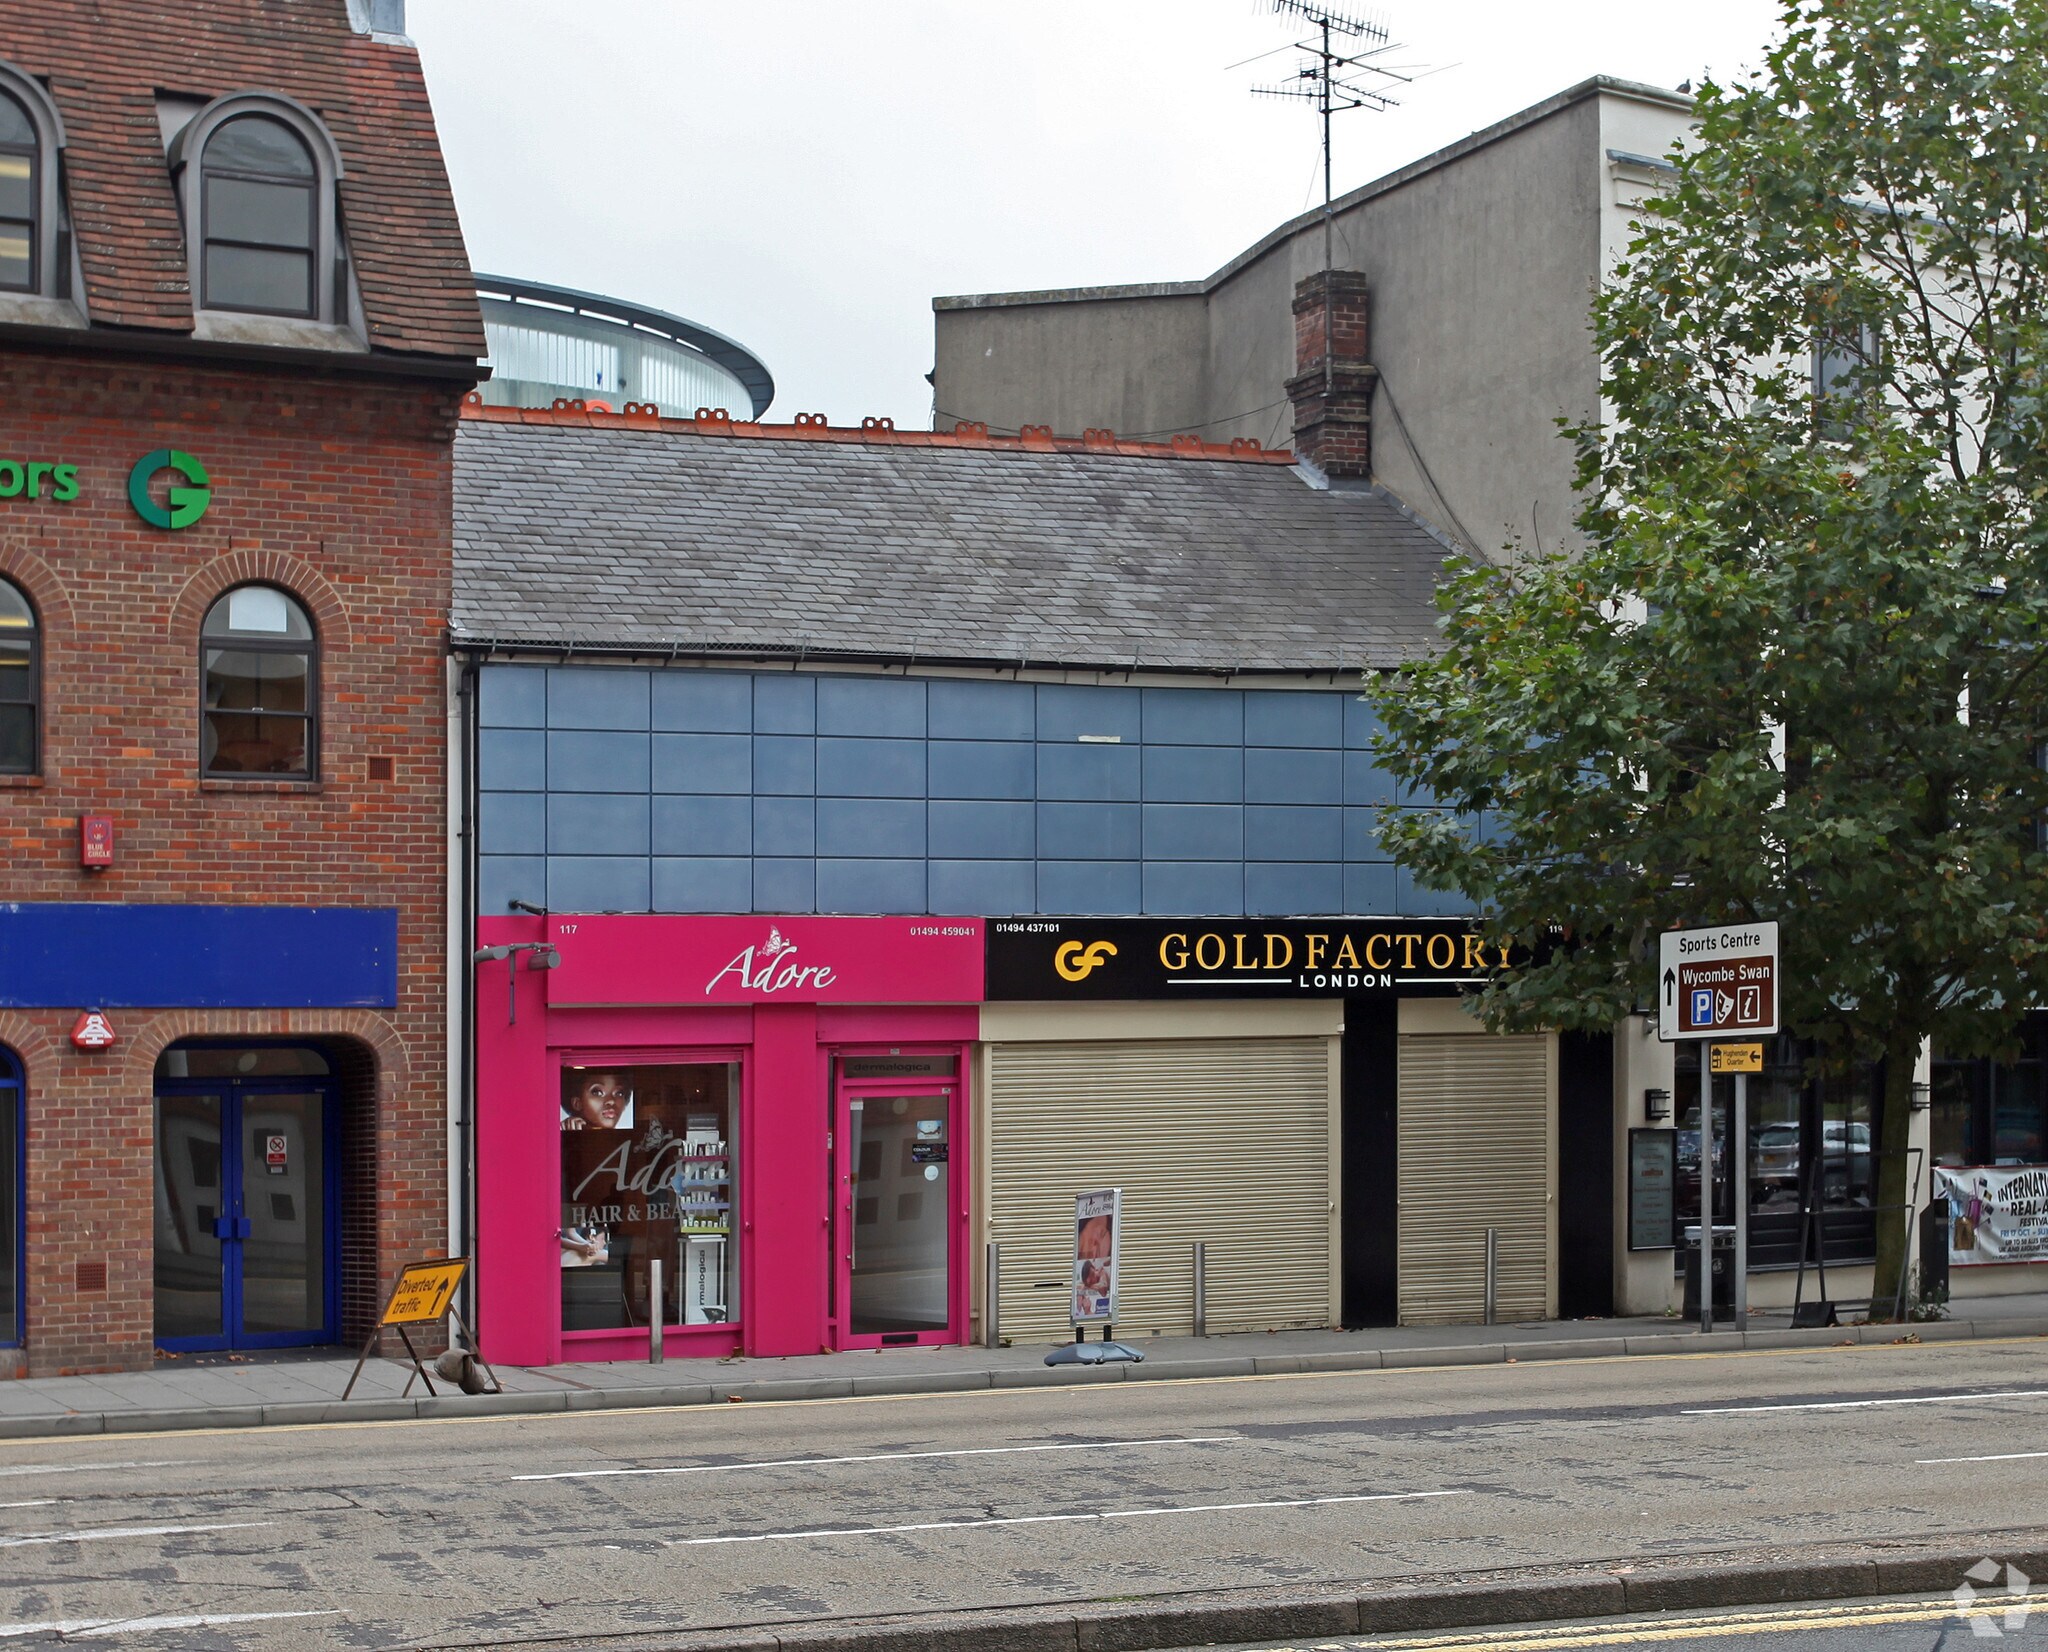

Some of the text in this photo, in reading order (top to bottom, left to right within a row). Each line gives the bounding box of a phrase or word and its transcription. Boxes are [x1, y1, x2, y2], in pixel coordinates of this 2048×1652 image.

[0, 460, 80, 501] ors
[560, 925, 577, 934] 117
[910, 927, 976, 936] 01494 459041
[996, 923, 1060, 932] 01494 437101
[1159, 933, 1293, 970] GOLD
[1679, 932, 1760, 954] Sports Centre
[705, 945, 837, 995] Adore
[1682, 964, 1770, 987] Wycombe Swan
[1300, 974, 1391, 987] LONDON
[853, 1063, 931, 1073] dermalogica
[1726, 1058, 1744, 1066] Quarter
[1998, 1171, 2048, 1203] INTERNATI
[572, 1204, 622, 1225] HAIR
[627, 1203, 641, 1222] &
[2018, 1228, 2030, 1237] OCT
[398, 1276, 438, 1294] Diverted
[392, 1297, 421, 1315] traffic
